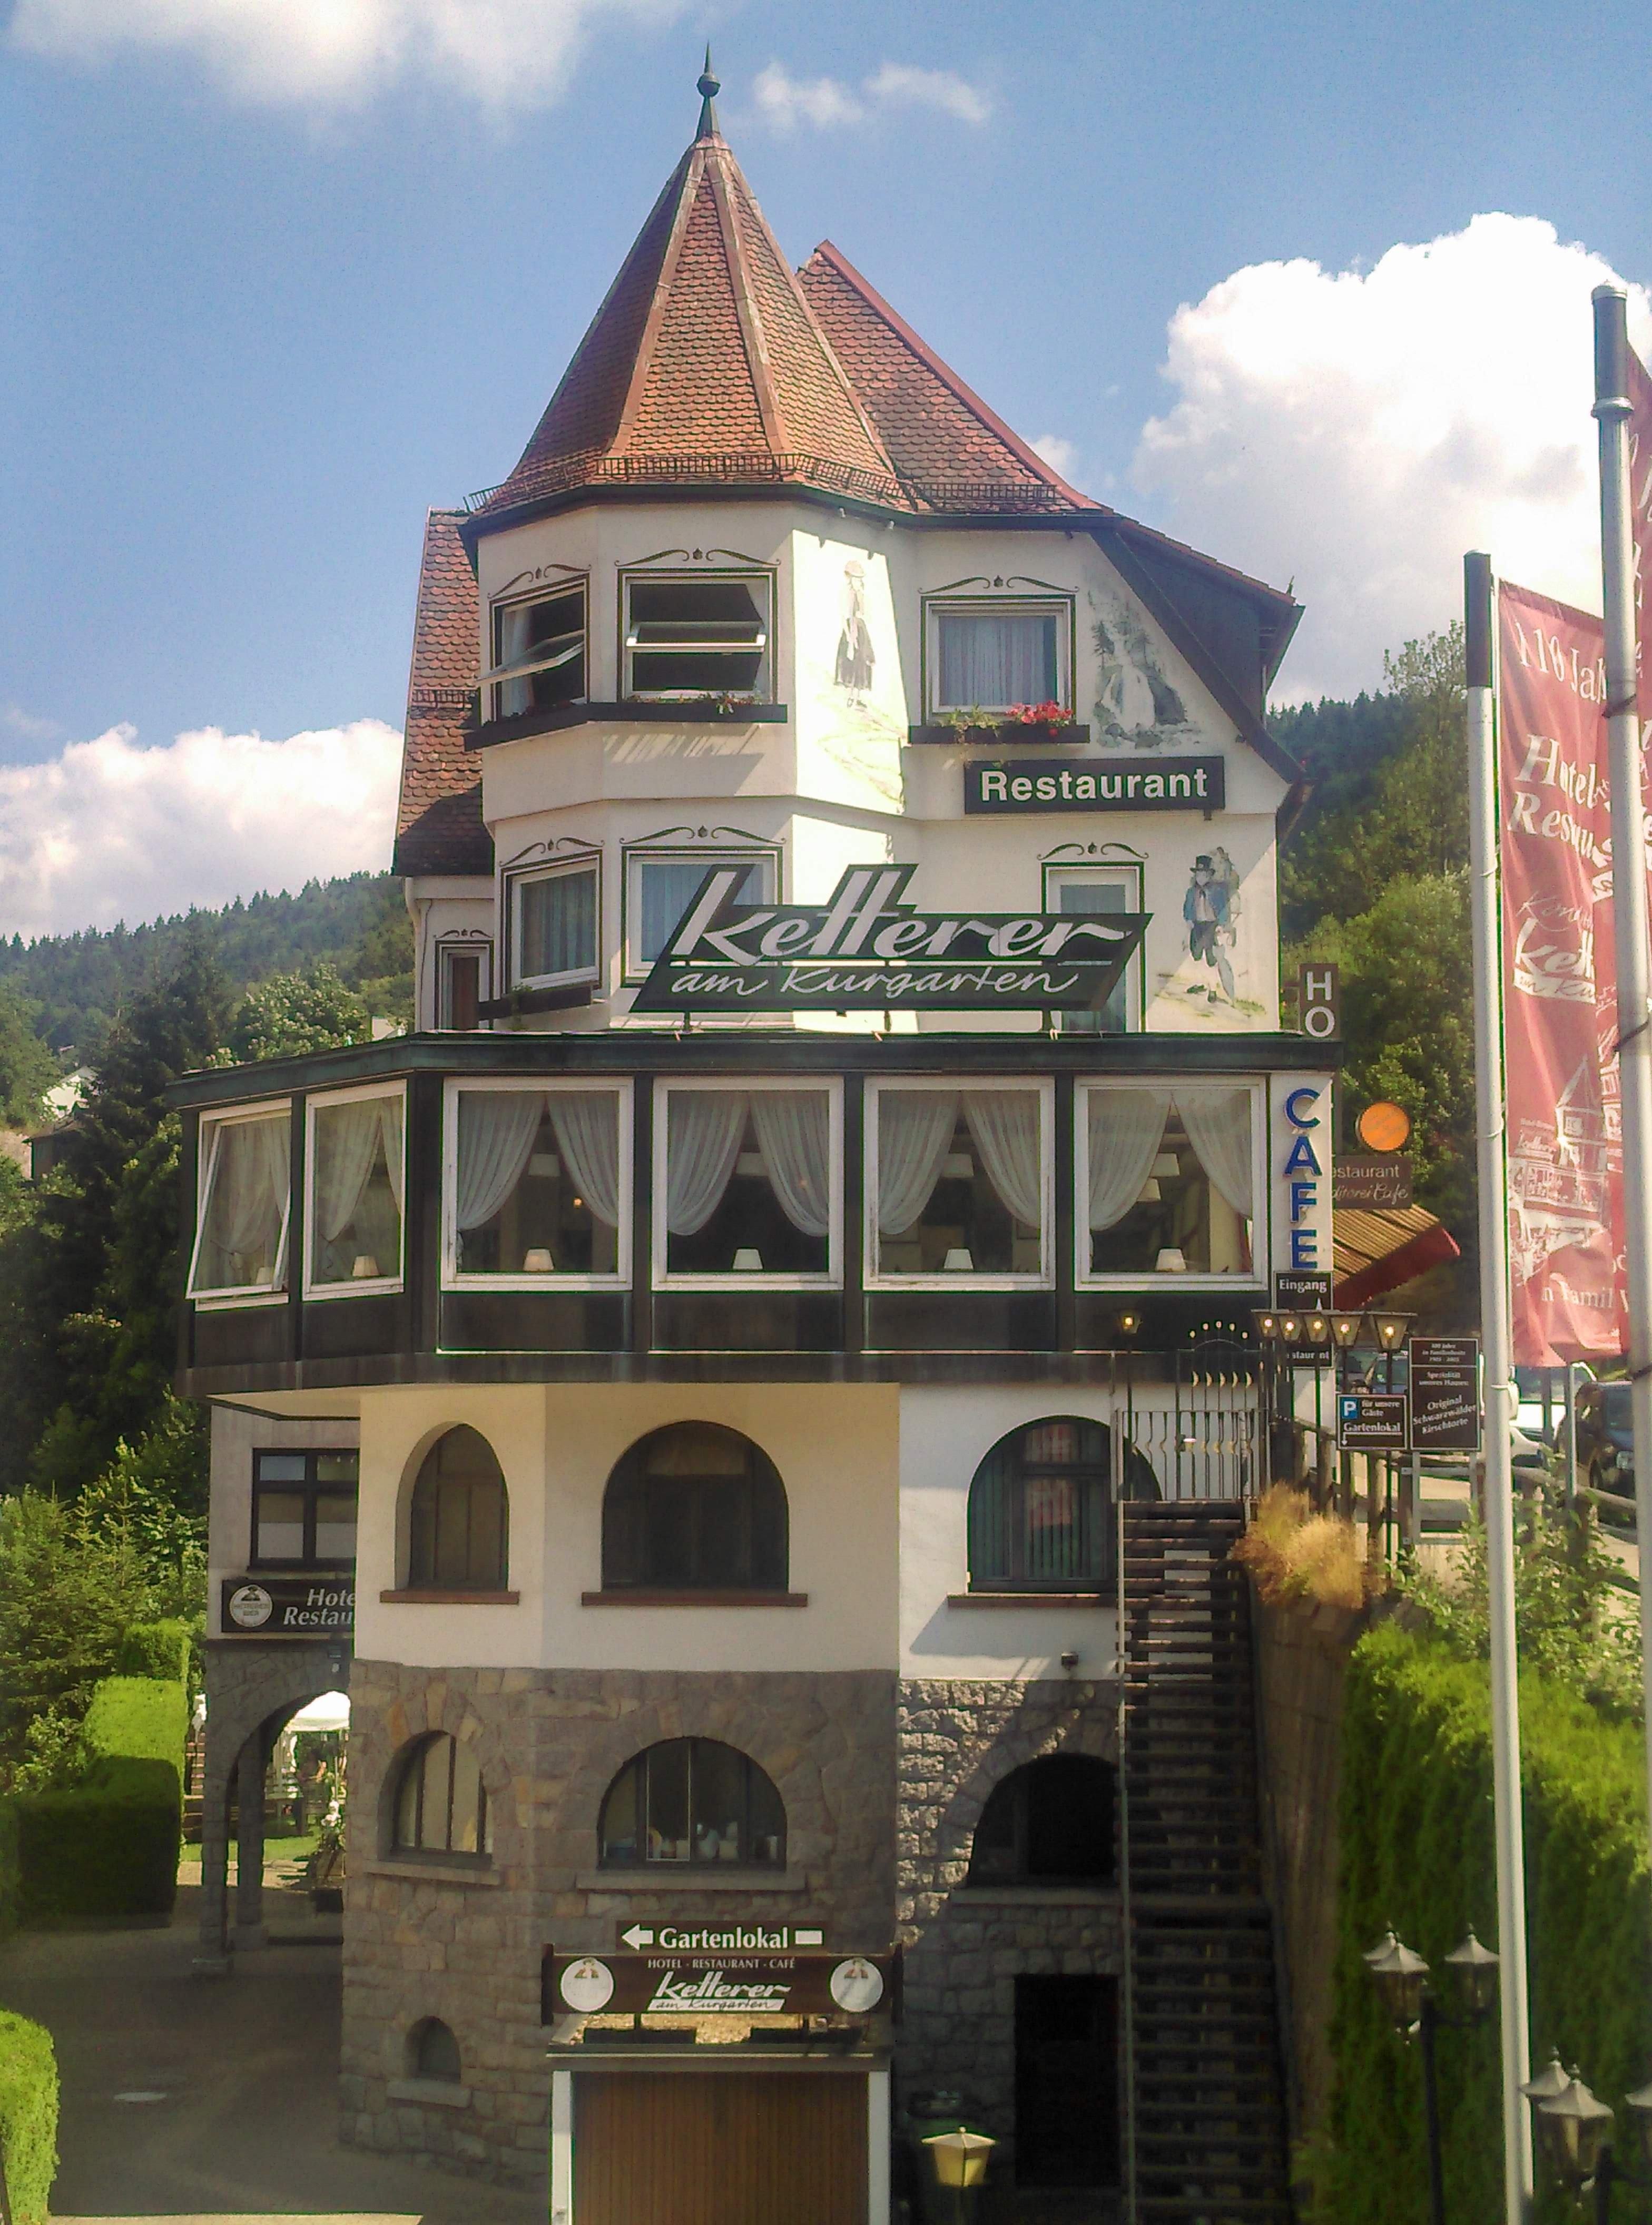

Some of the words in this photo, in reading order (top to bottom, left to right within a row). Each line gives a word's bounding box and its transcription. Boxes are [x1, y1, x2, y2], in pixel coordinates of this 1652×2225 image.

[1570, 648, 1607, 704] Jah
[981, 768, 1207, 801] Restaurant
[671, 871, 1132, 966] Ketterer
[671, 970, 769, 996] am
[781, 966, 1079, 1000] Kurgarten
[1283, 1087, 1323, 1270] CAFE
[1334, 1165, 1399, 1178] staurant
[1279, 1279, 1328, 1293] Eingang
[1286, 1351, 1330, 1359] staurnt
[1344, 1401, 1356, 1416] P
[1427, 1394, 1462, 1411] Original
[1344, 1422, 1401, 1432] Gartenlokal
[307, 1588, 355, 1606] Hote
[283, 1606, 352, 1626] Restau
[659, 1926, 788, 1948] Gartenlokal
[648, 1958, 682, 1968] HOTEL
[692, 1958, 760, 1968] RESTAURANT
[769, 1957, 795, 1968] CAFÉ
[655, 1971, 792, 2000] Ketterer
